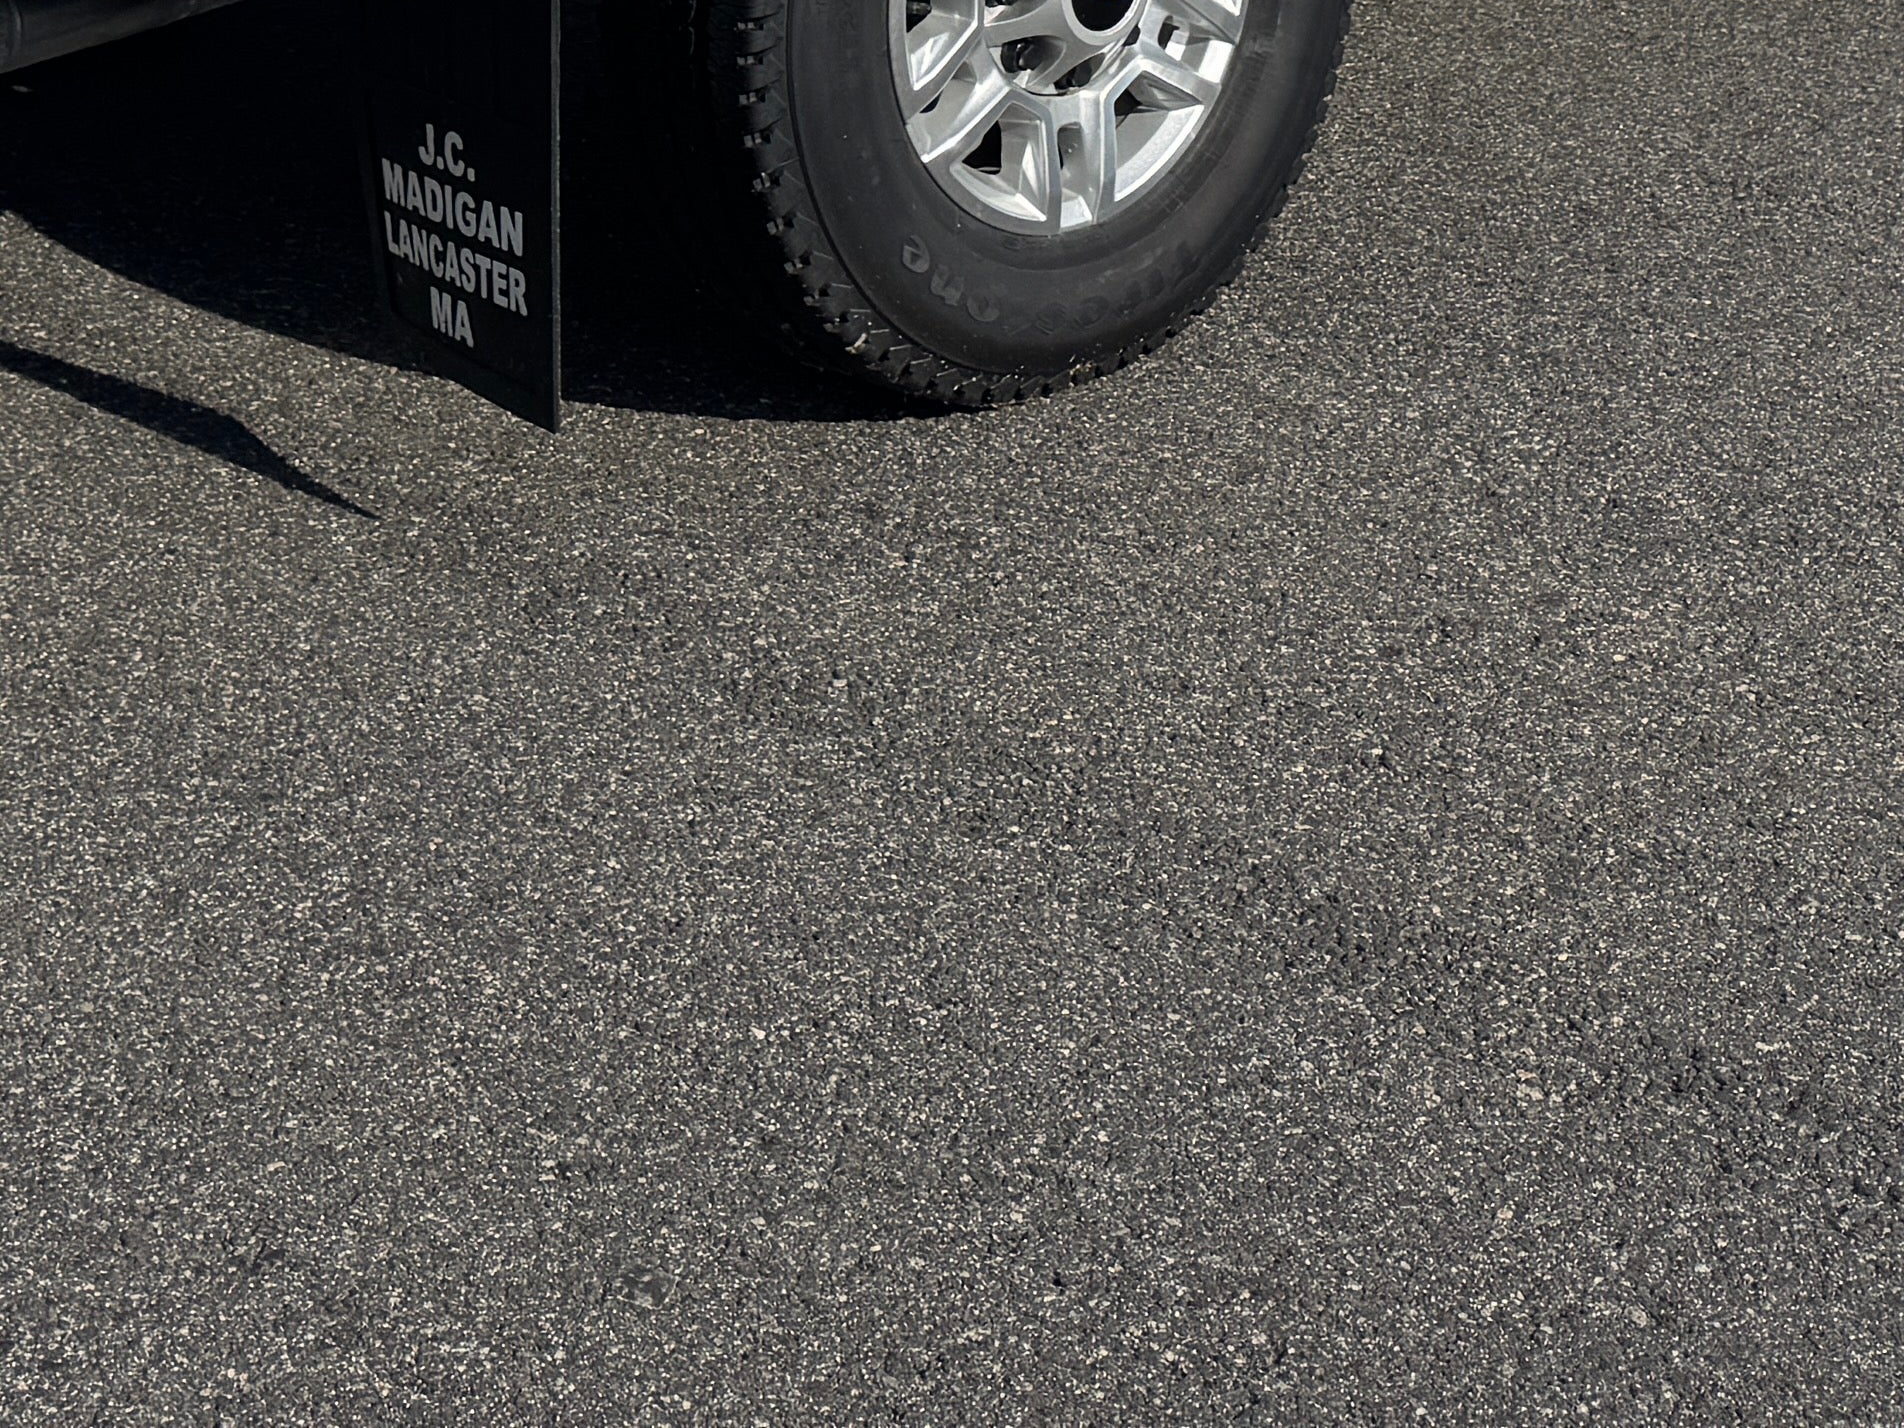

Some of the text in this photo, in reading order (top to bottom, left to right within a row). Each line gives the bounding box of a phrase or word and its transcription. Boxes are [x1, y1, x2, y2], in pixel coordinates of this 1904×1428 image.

[418, 123, 476, 182] J.C.
[381, 158, 524, 257] MADIGAN
[384, 210, 528, 317] LANCASTER
[429, 286, 475, 349] MA
